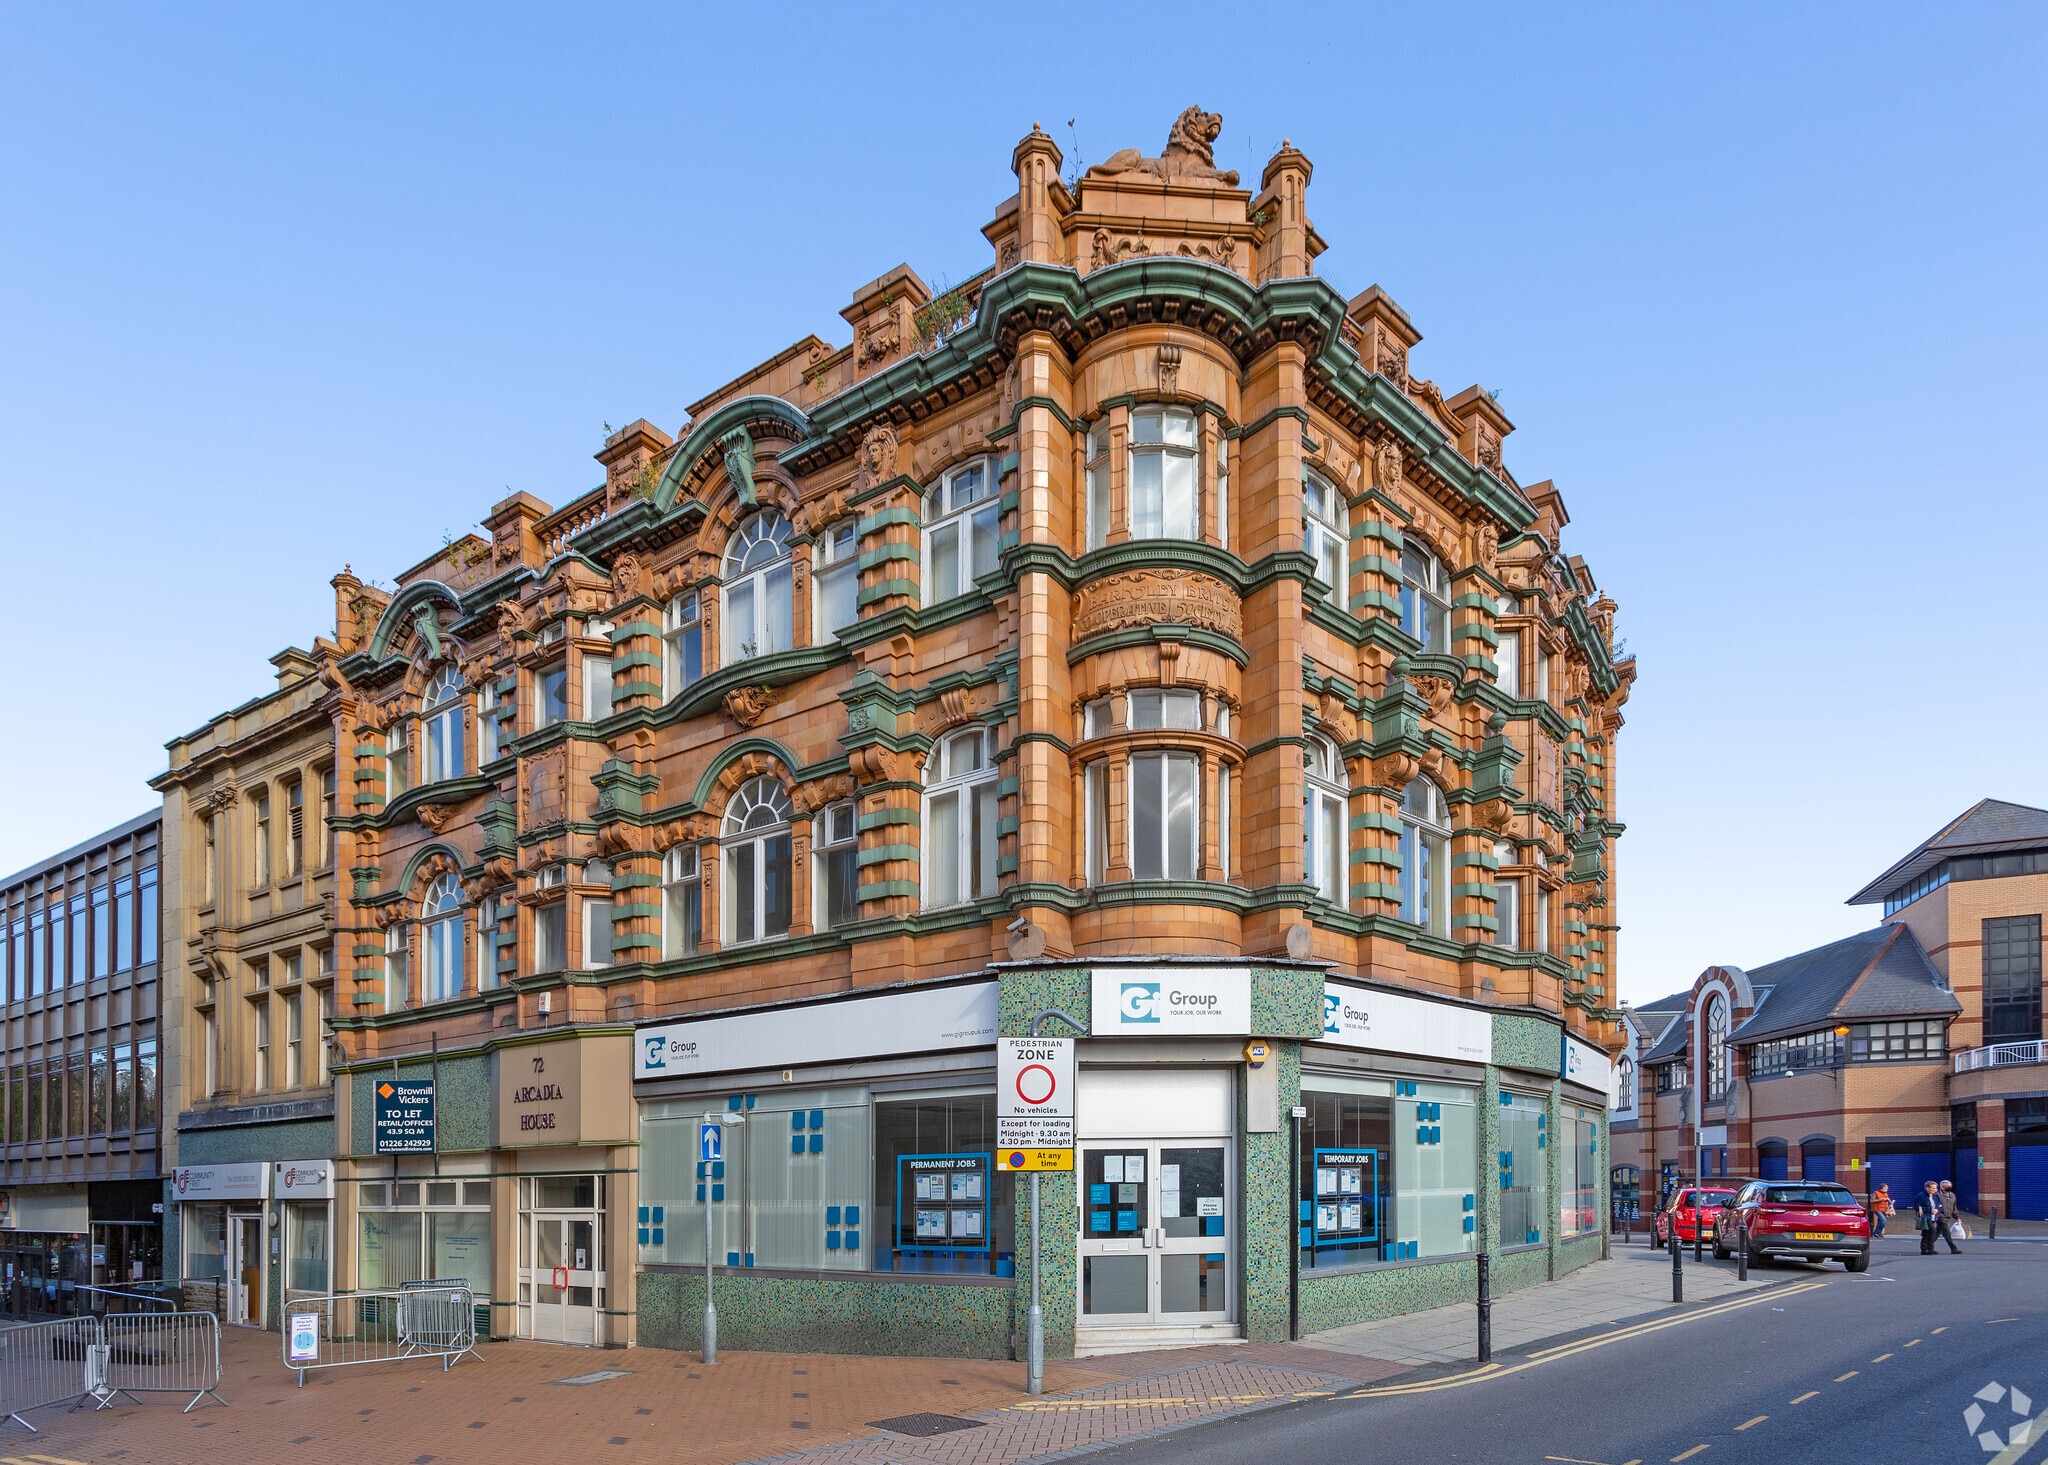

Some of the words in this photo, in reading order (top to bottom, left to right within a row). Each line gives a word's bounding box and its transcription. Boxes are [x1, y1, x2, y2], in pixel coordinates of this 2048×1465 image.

[1169, 990, 1218, 1010] Group
[1343, 1005, 1369, 1025] Group
[670, 1040, 697, 1054] Group
[1009, 1040, 1063, 1048] PEDESTRIAN
[1017, 1049, 1055, 1060] ZONE
[1252, 1047, 1264, 1055] ADT
[532, 1056, 545, 1073] 72
[397, 1086, 433, 1096] Brownill
[513, 1084, 564, 1104] ARCADIA
[398, 1095, 430, 1104] Vickers
[385, 1109, 402, 1118] TO
[404, 1109, 422, 1118] LET
[1014, 1106, 1025, 1114] No
[1027, 1106, 1058, 1114] vehicles
[377, 1119, 434, 1128] RETAIL/OFFICES
[520, 1113, 556, 1131] HOUSE
[1001, 1120, 1028, 1129] Except
[1042, 1120, 1071, 1129] loading
[1000, 1130, 1034, 1138] Midnight
[379, 1139, 403, 1147] 01226
[403, 1139, 431, 1147] 242929
[1037, 1138, 1071, 1146] Midnight
[1324, 1155, 1355, 1163] TEMPORARY
[1355, 1155, 1369, 1163] JOBS
[910, 1160, 955, 1169] PERMANENT
[956, 1159, 976, 1168] JOBS
